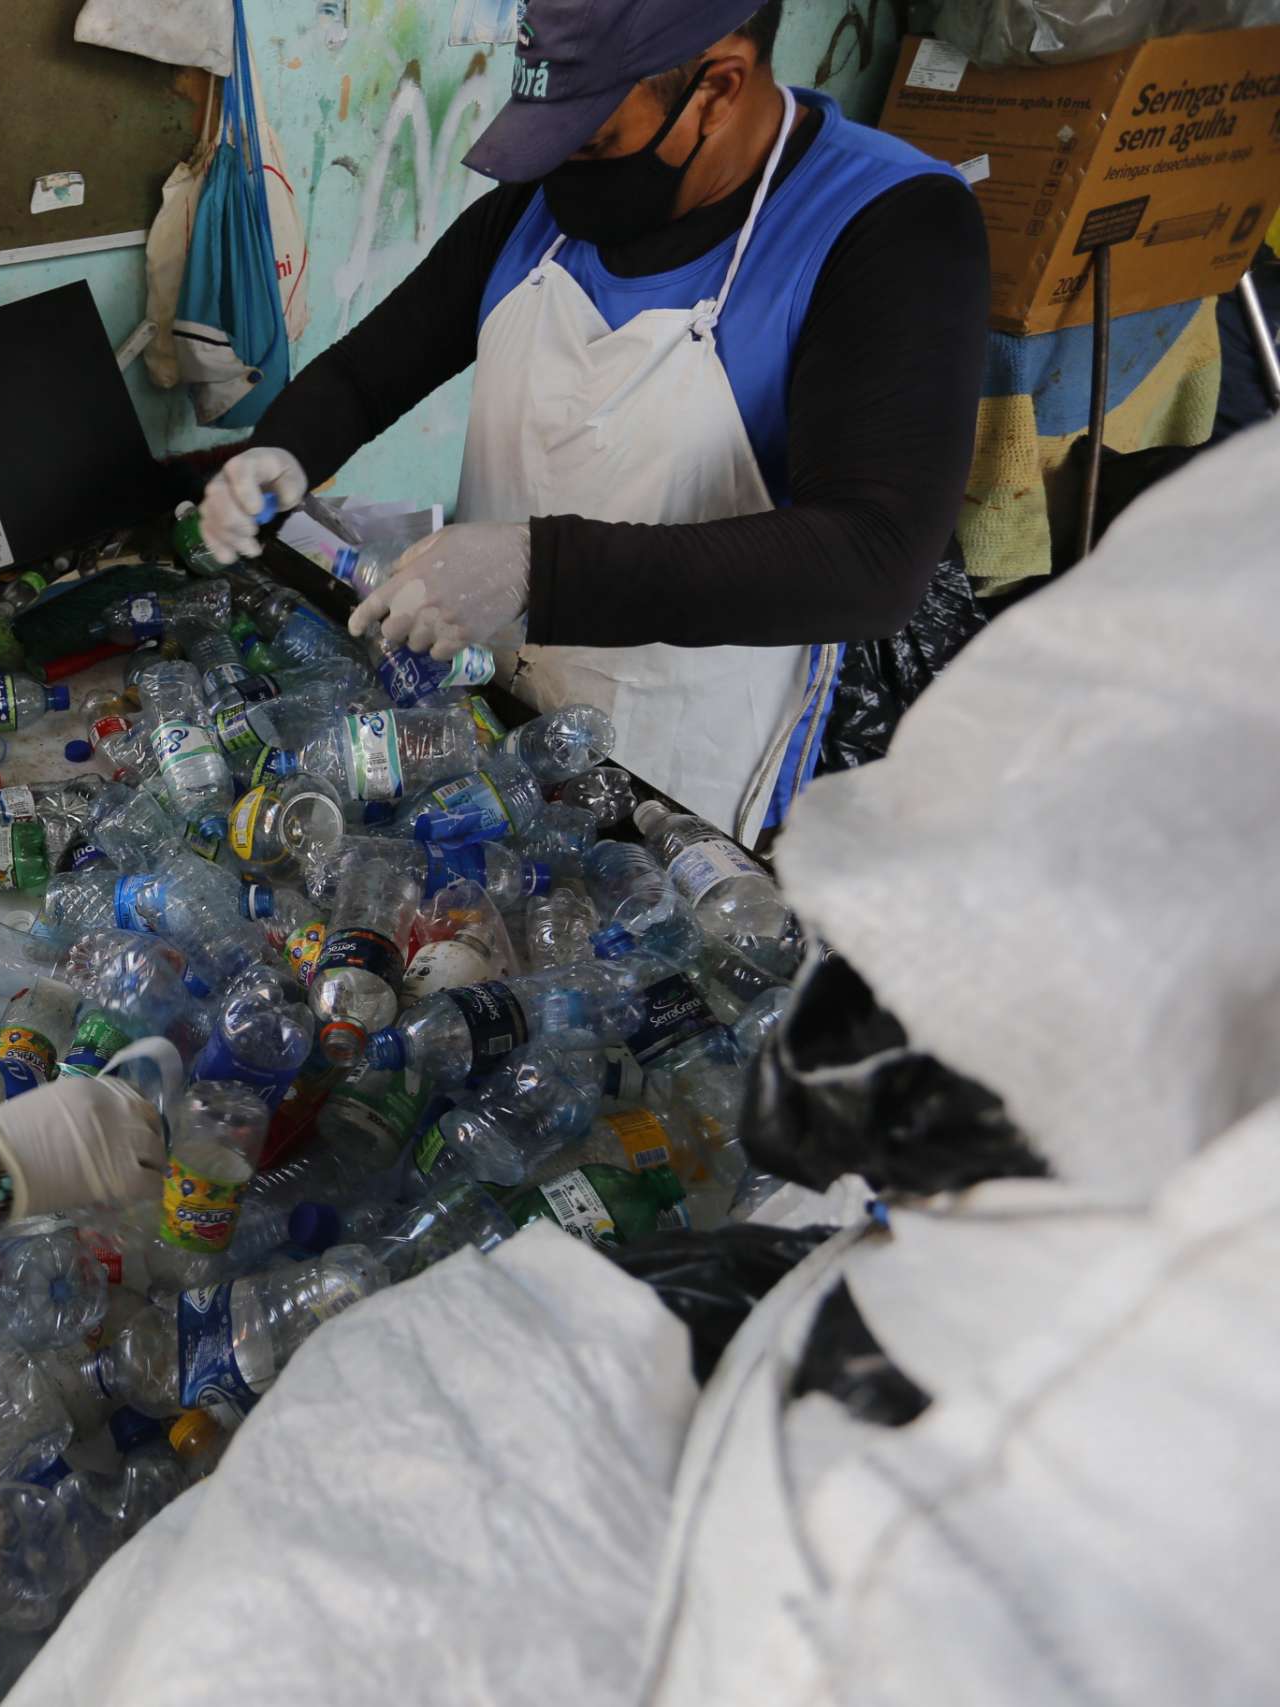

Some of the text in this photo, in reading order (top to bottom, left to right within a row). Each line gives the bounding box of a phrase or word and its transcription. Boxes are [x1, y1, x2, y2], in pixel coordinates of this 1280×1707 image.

[1131, 79, 1229, 118] Seringas
[1113, 106, 1237, 153] sem agulha
